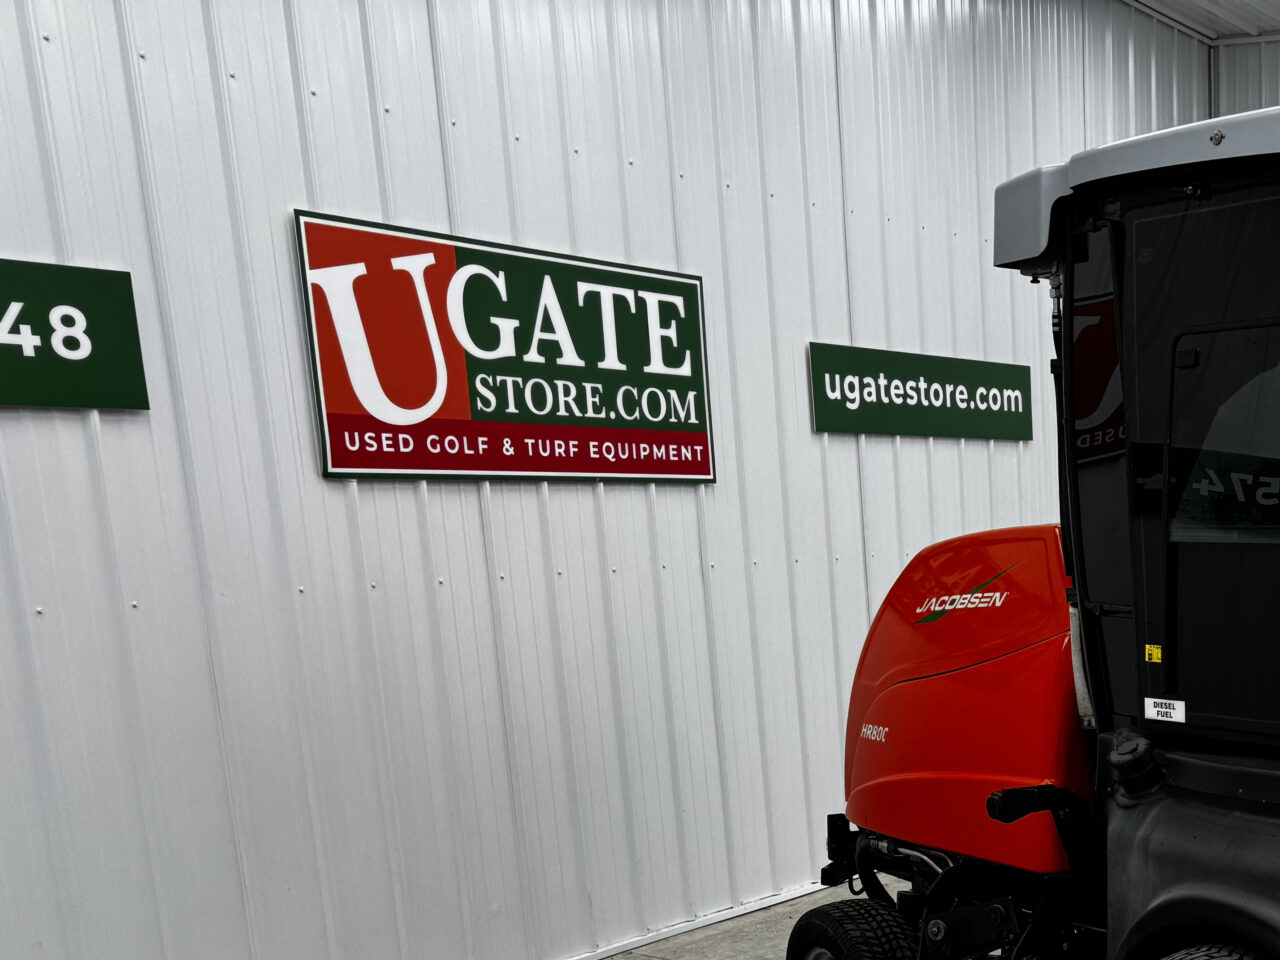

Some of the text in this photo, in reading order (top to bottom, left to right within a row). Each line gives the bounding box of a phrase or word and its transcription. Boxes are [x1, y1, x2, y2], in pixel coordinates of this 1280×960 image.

[0, 301, 93, 360] 48
[308, 252, 692, 426] UGATE
[474, 373, 700, 424] STORE.COM
[824, 372, 1023, 412] ugatestore.com
[344, 431, 704, 462] USED GOLF & TURF EQUIPMENT
[915, 592, 1008, 614] JACOBSEN
[1153, 701, 1176, 711] DIESEL
[1156, 710, 1174, 719] FUEL
